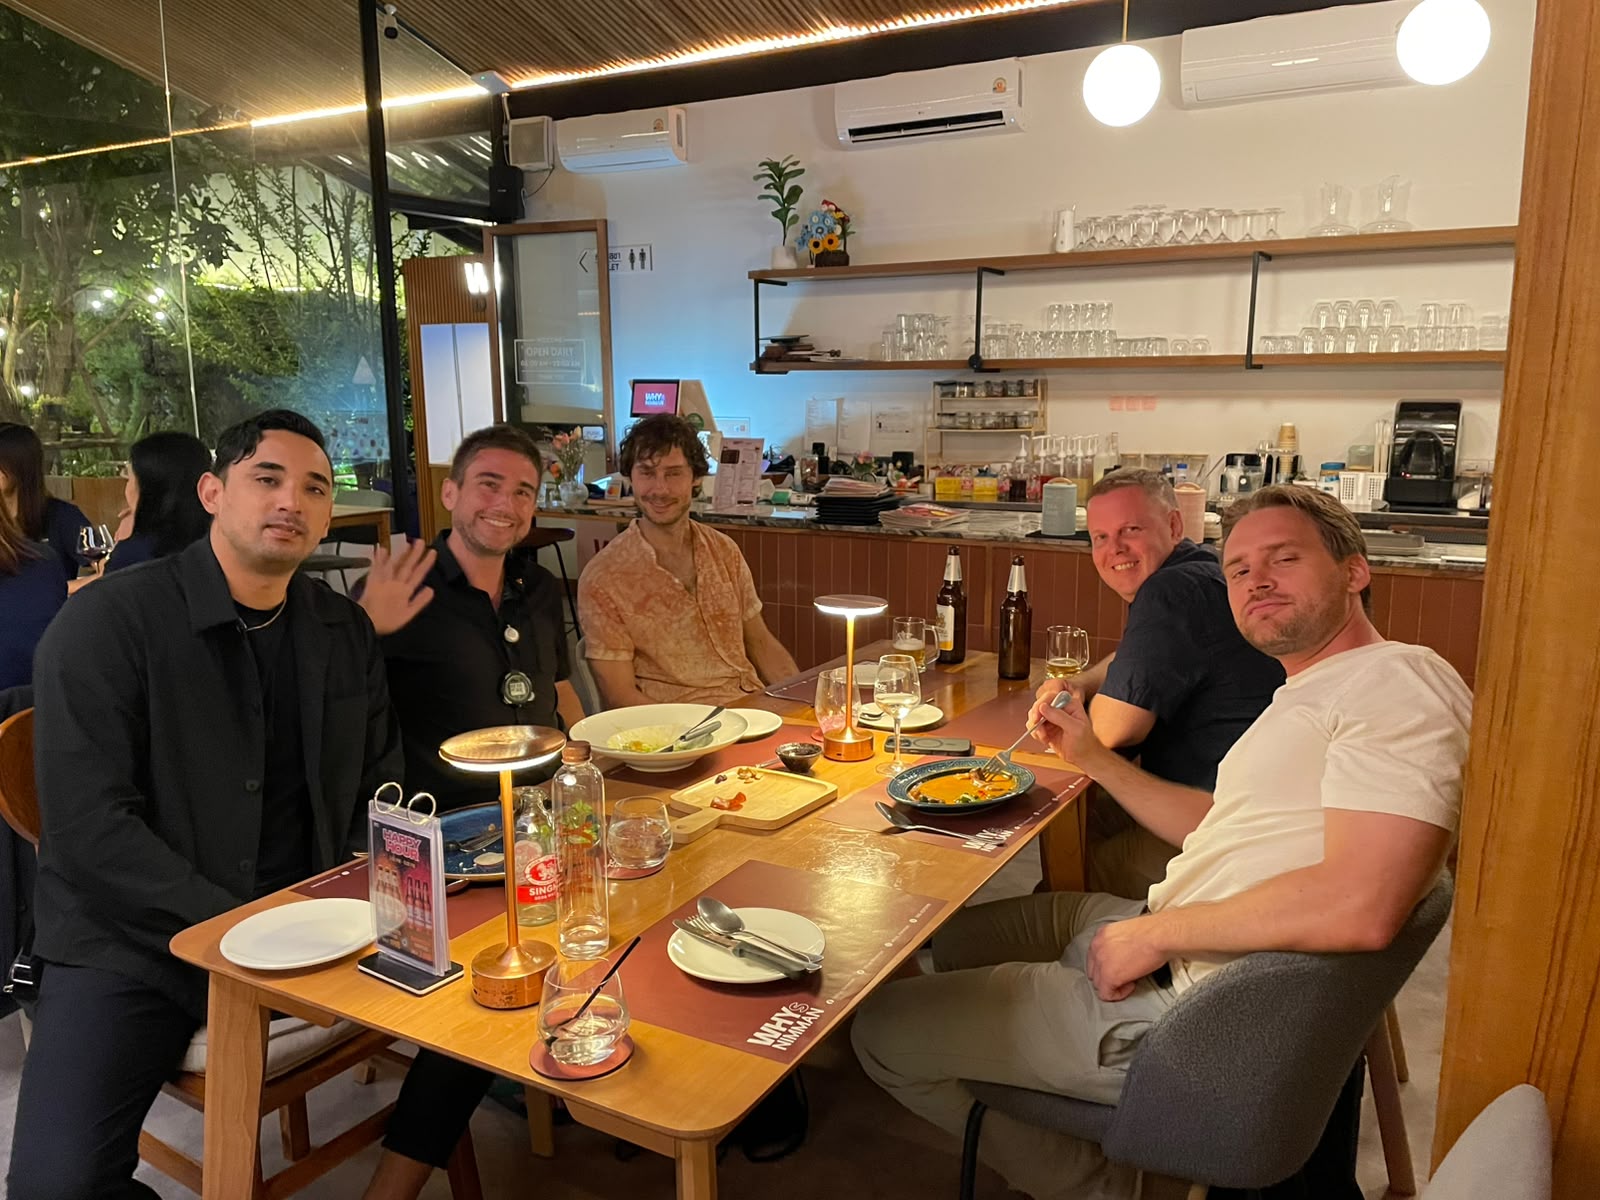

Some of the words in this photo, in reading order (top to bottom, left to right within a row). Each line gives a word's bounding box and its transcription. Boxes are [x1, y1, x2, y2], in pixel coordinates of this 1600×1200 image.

[526, 346, 549, 357] OPEN
[551, 346, 575, 357] DAILY
[383, 828, 421, 849] HAPPY
[385, 839, 420, 862] HOUR
[771, 1007, 825, 1051] NIMMAN
